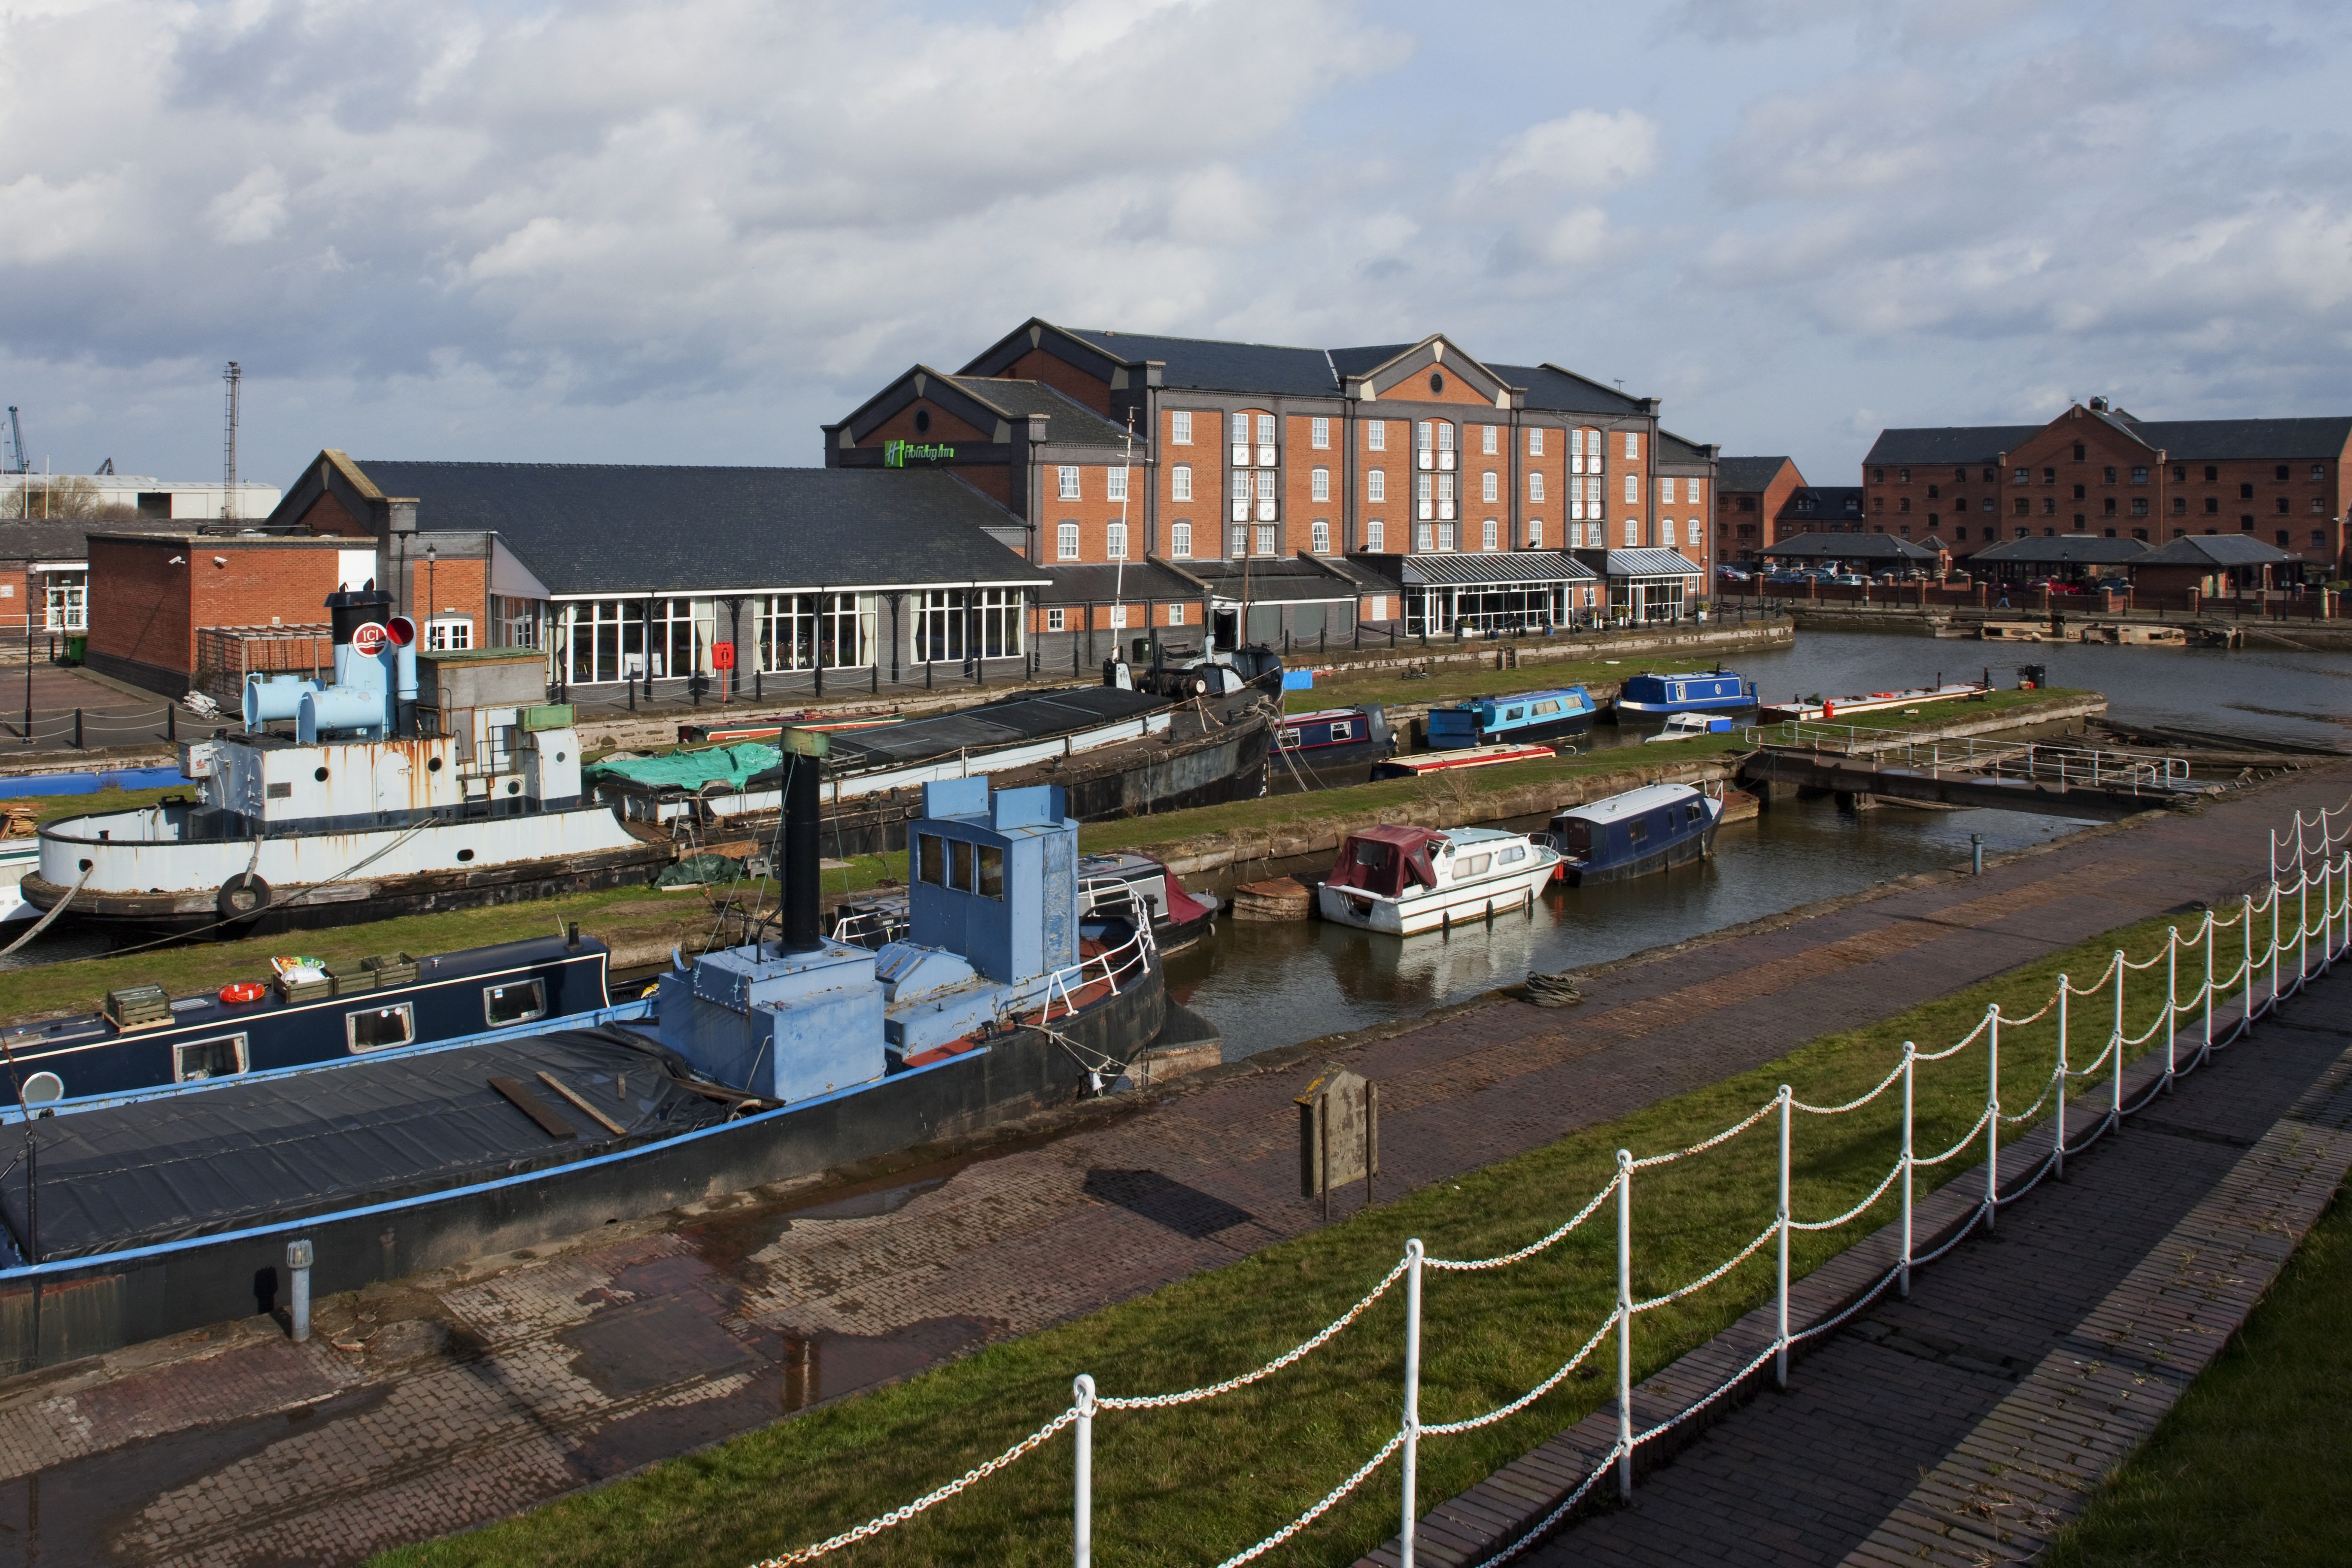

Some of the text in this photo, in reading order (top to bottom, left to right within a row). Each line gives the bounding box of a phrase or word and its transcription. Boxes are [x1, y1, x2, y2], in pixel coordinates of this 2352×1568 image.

[904, 444, 954, 461] Holiday Inn
[363, 629, 379, 642] ICI
